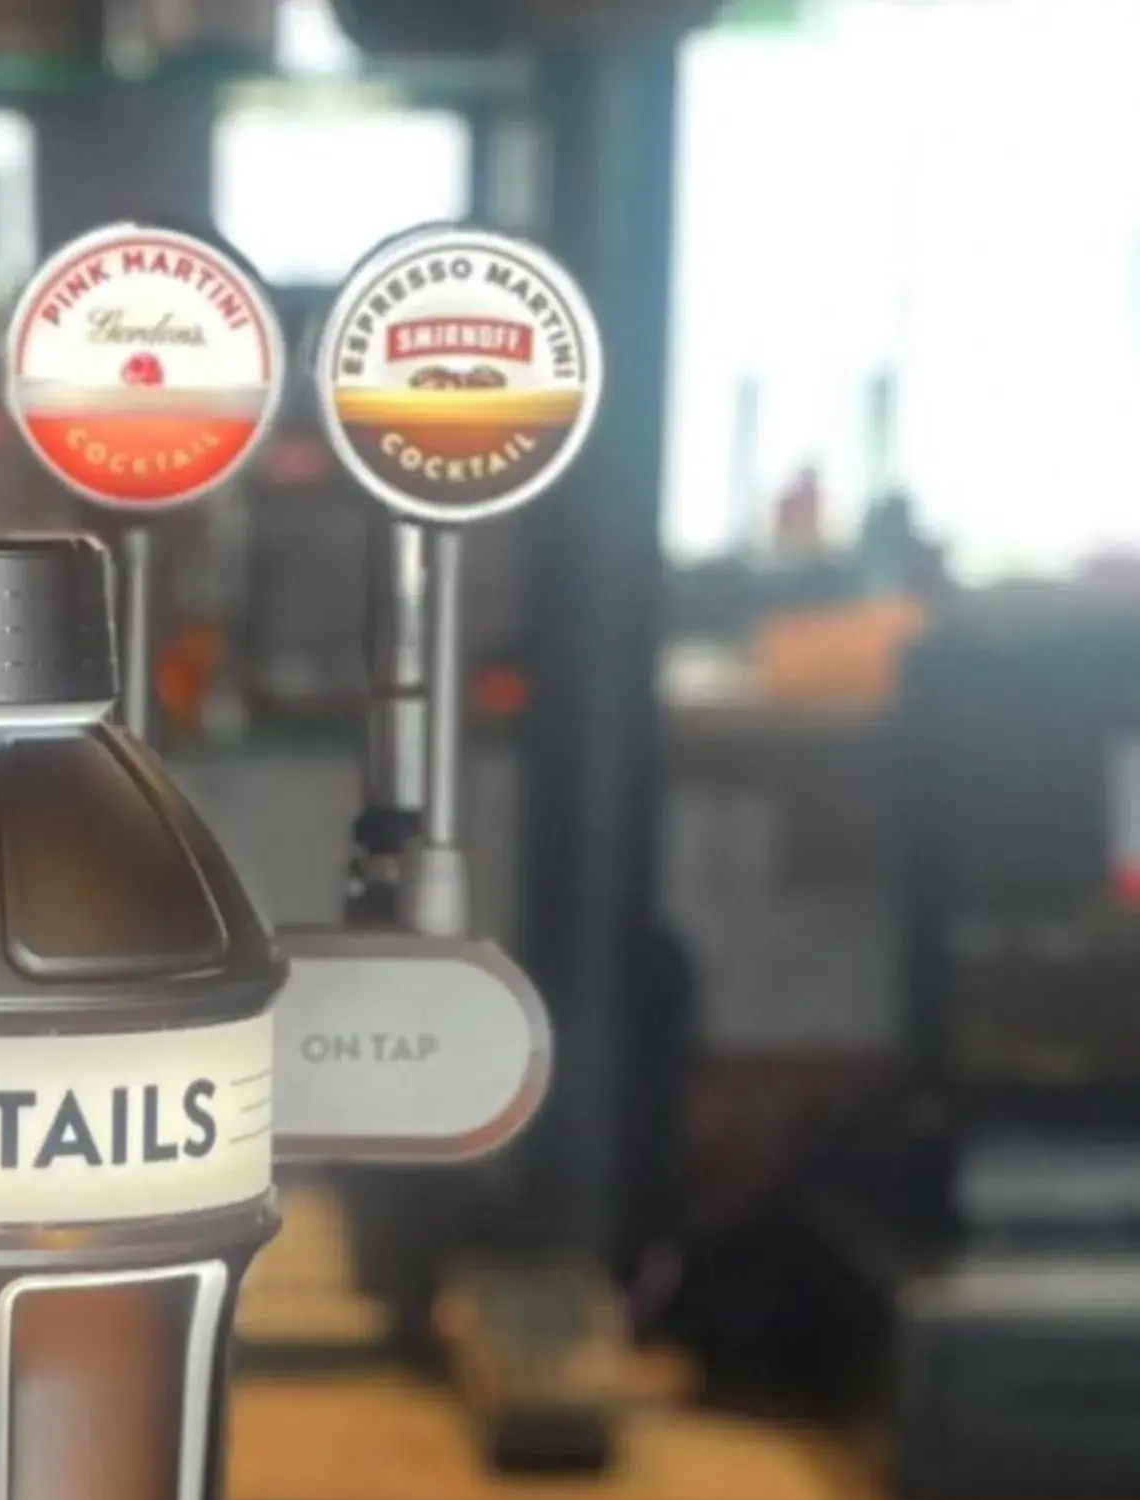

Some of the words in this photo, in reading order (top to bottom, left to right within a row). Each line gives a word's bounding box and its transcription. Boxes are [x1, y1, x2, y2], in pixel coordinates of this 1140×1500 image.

[41, 261, 111, 327] PINK
[120, 249, 250, 332] MARTINI
[341, 257, 473, 376] ESPRESSO
[484, 262, 577, 379] MARTINI
[396, 322, 521, 352] SMIRNOFF
[65, 427, 220, 477] COCKTAIL
[380, 431, 537, 482] COCKTAIL
[299, 1032, 361, 1064] ON
[370, 1032, 441, 1063] TAP
